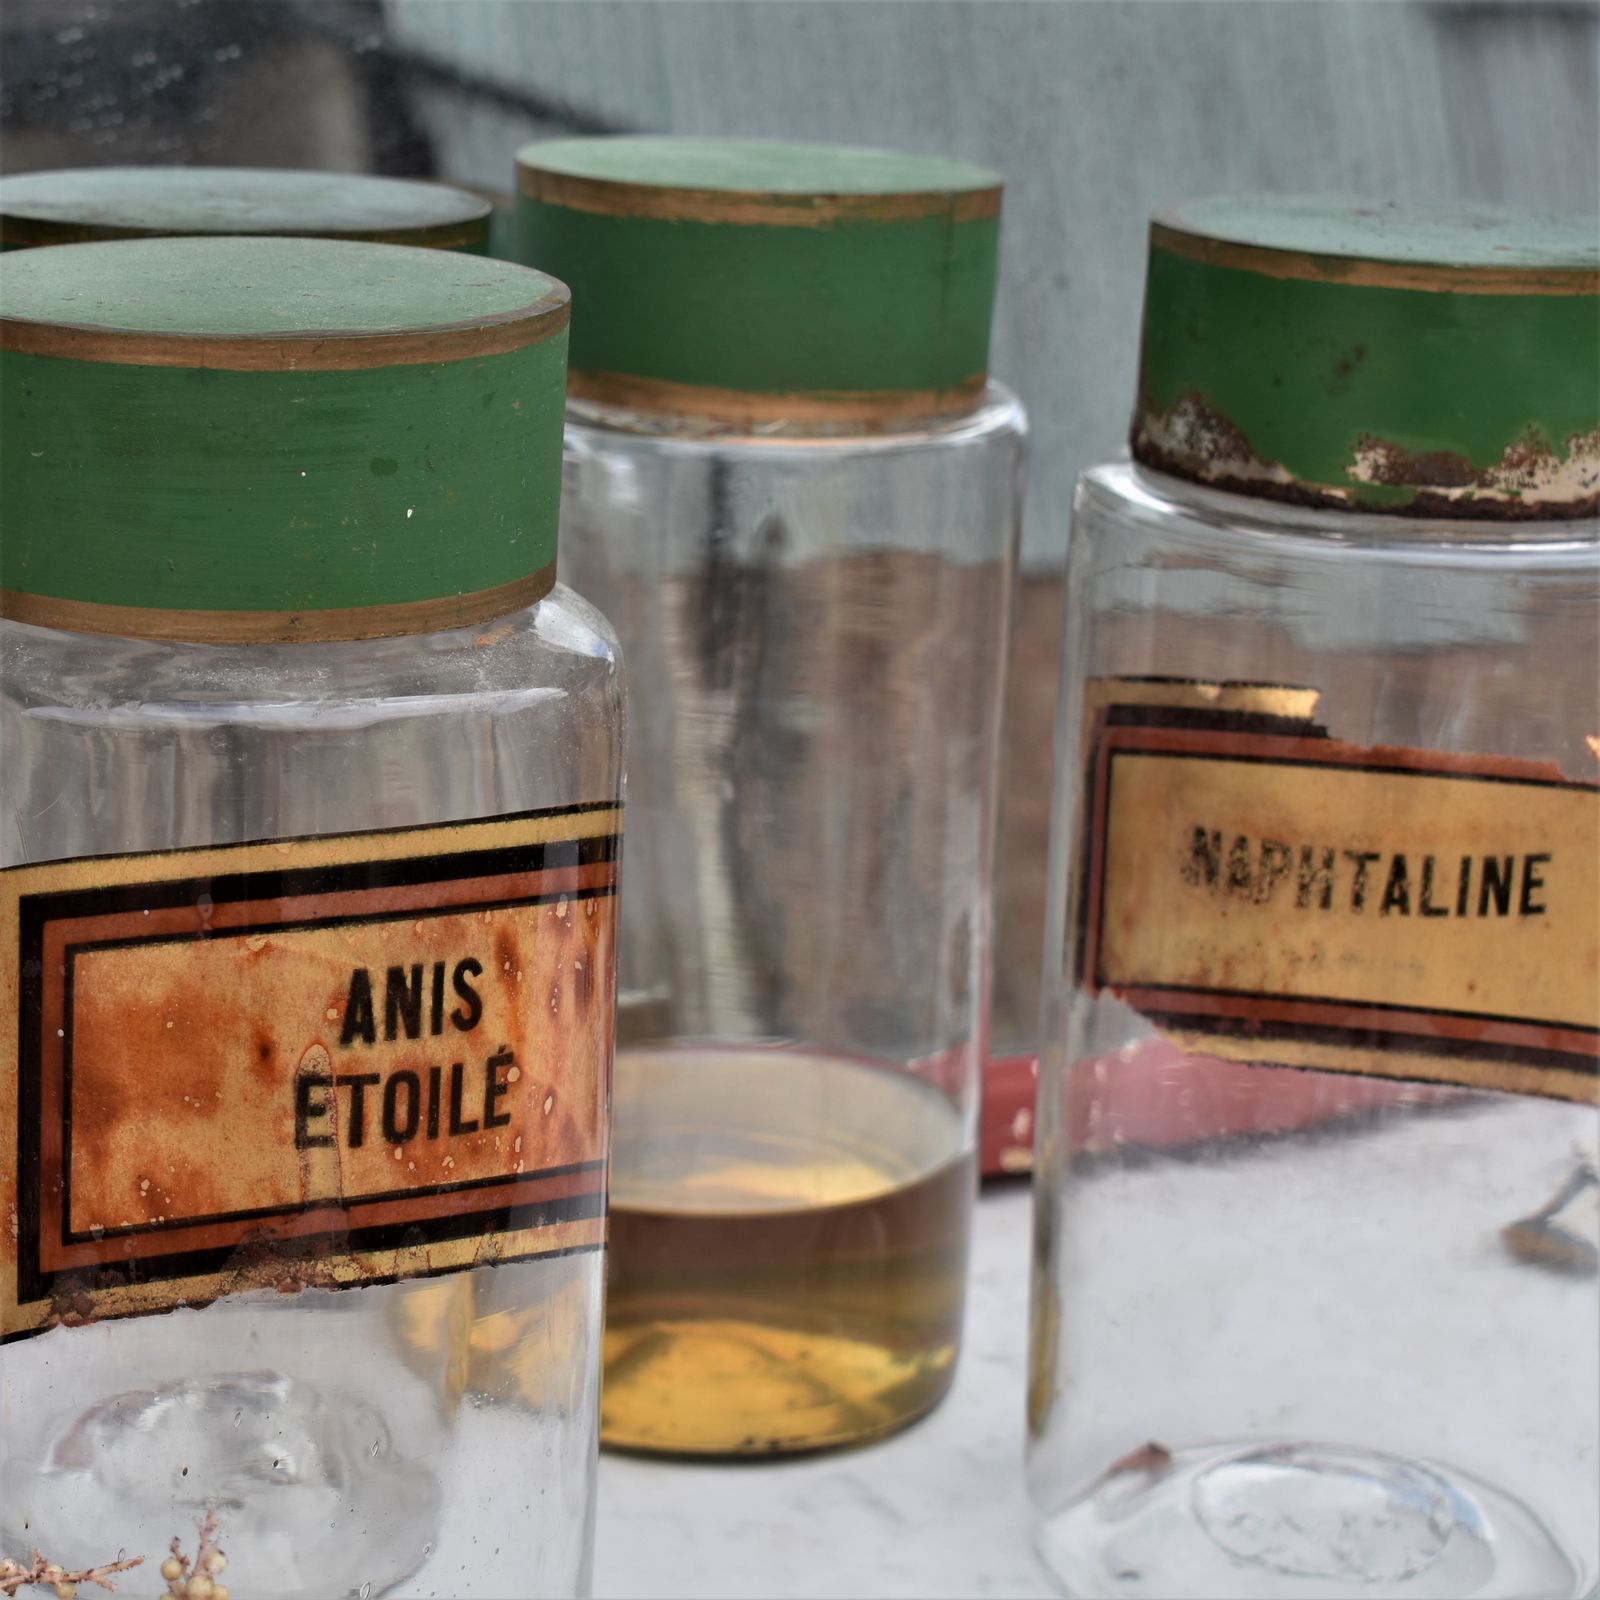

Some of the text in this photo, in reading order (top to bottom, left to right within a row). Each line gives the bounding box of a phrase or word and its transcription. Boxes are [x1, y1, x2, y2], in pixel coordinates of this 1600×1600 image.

[1184, 826, 1552, 917] NAPHTALINE
[340, 957, 483, 1045] ANIS
[295, 1045, 514, 1149] ETOILÉ
